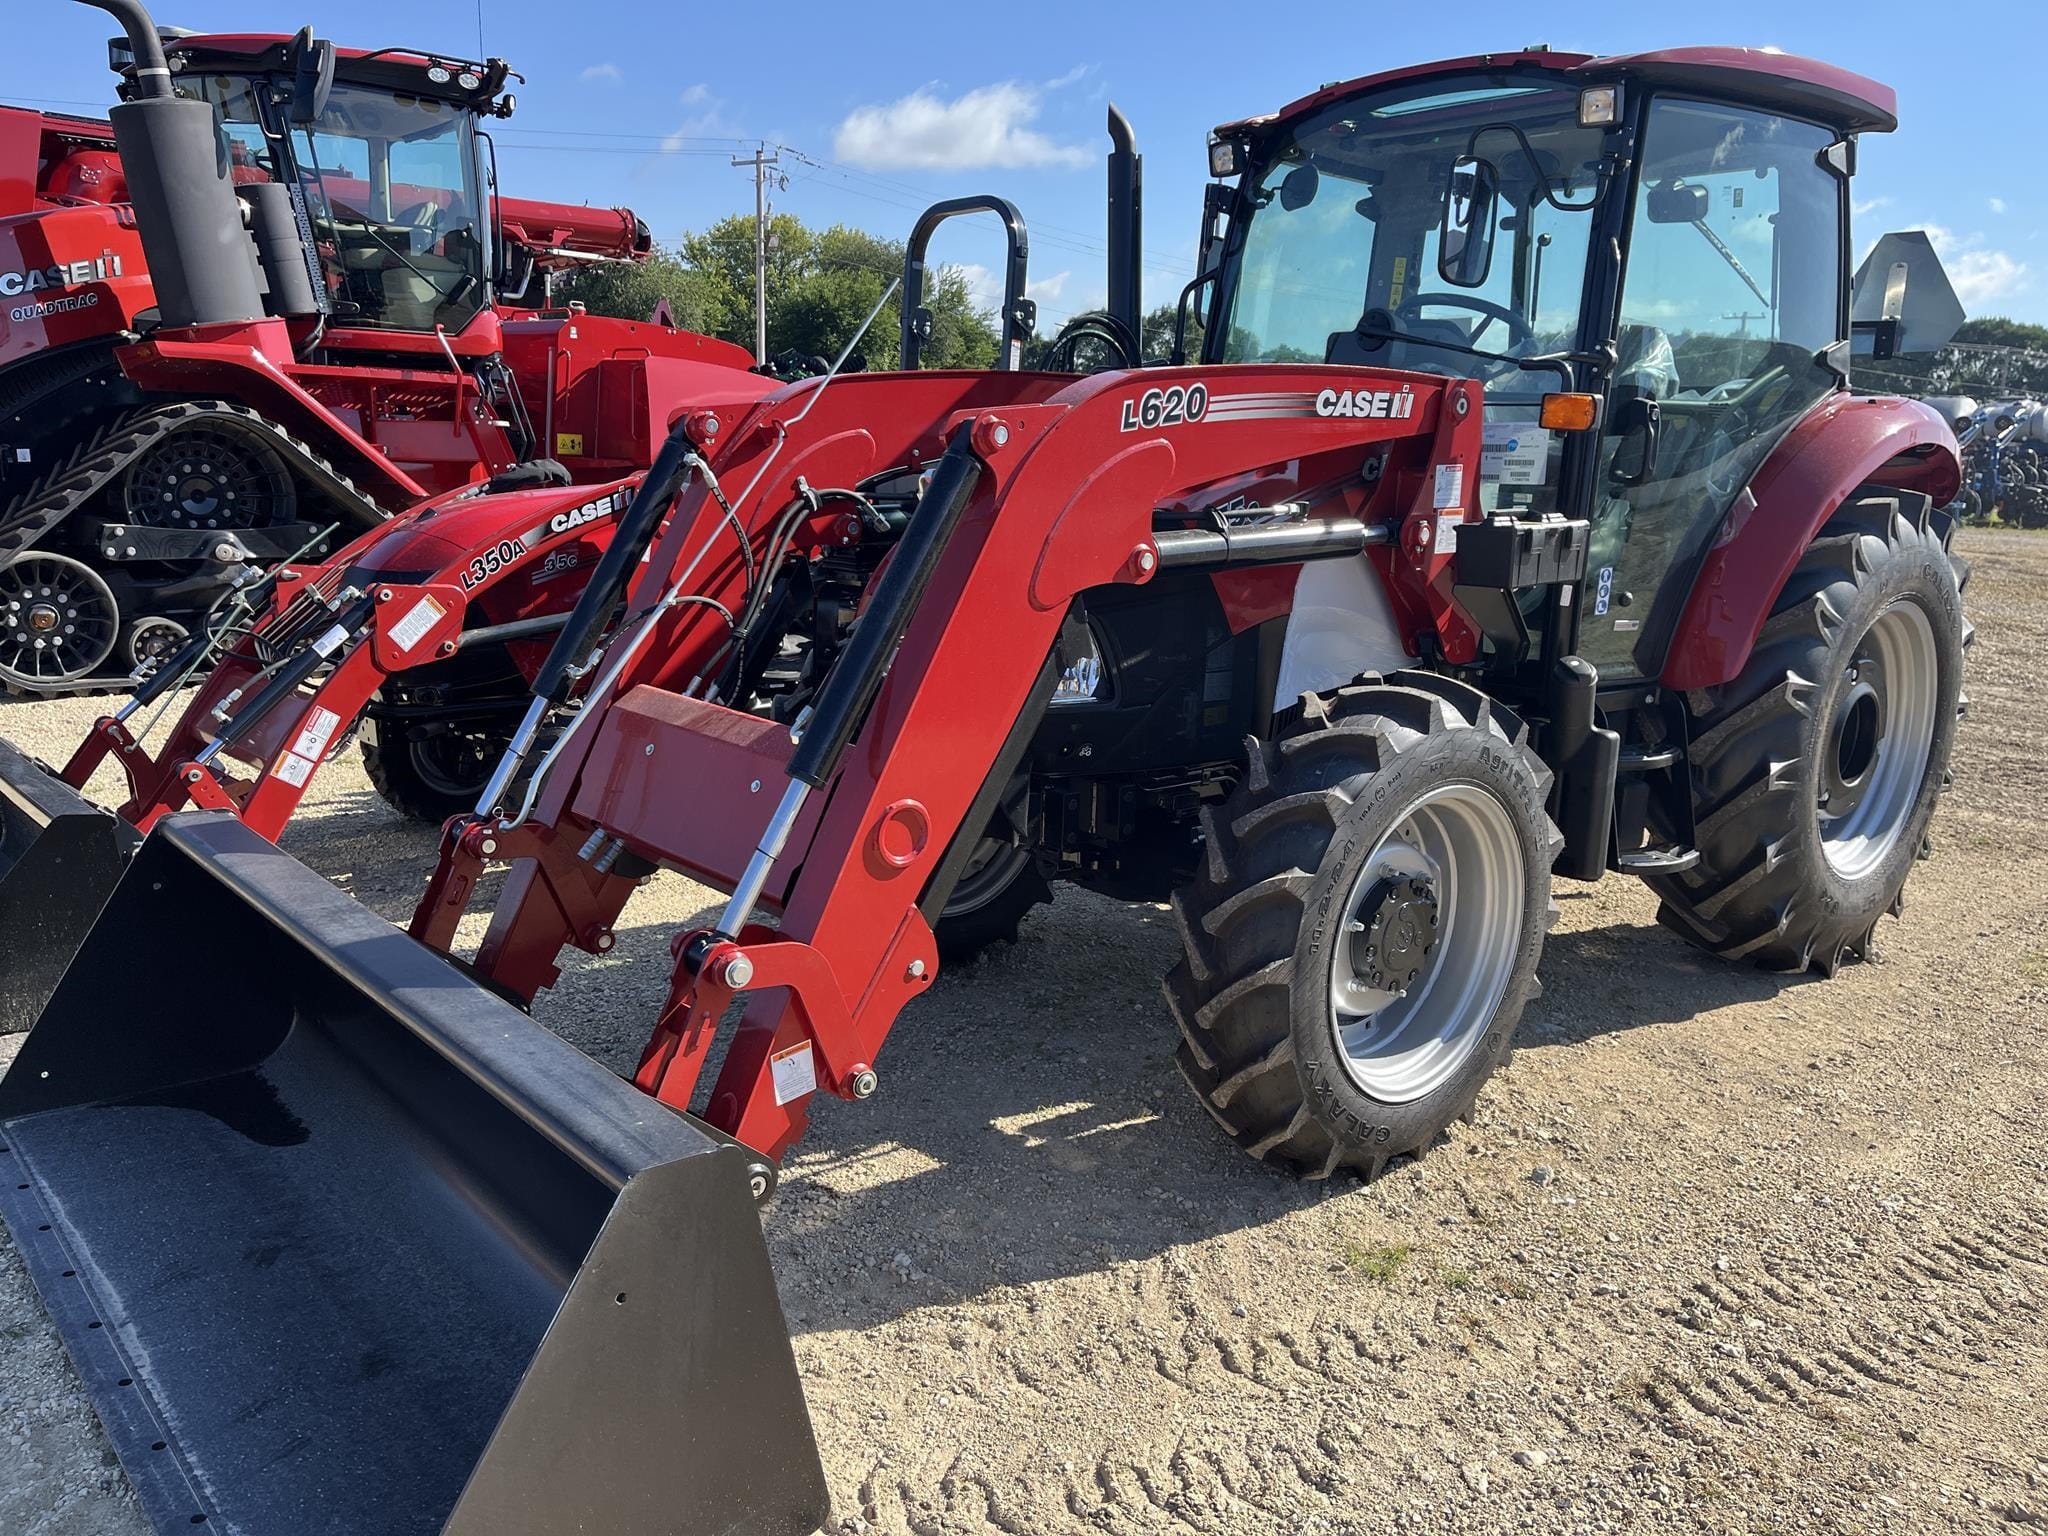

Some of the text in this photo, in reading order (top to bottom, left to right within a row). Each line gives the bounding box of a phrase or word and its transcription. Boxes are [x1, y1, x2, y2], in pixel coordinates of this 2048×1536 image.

[0, 260, 92, 296] CASE
[11, 293, 98, 322] QUADTRAC
[1120, 382, 1208, 432] L620
[1315, 389, 1390, 418] CASE
[550, 496, 613, 533] CASE
[459, 539, 528, 592] L350A
[1305, 1060, 1391, 1145] GALAXY
